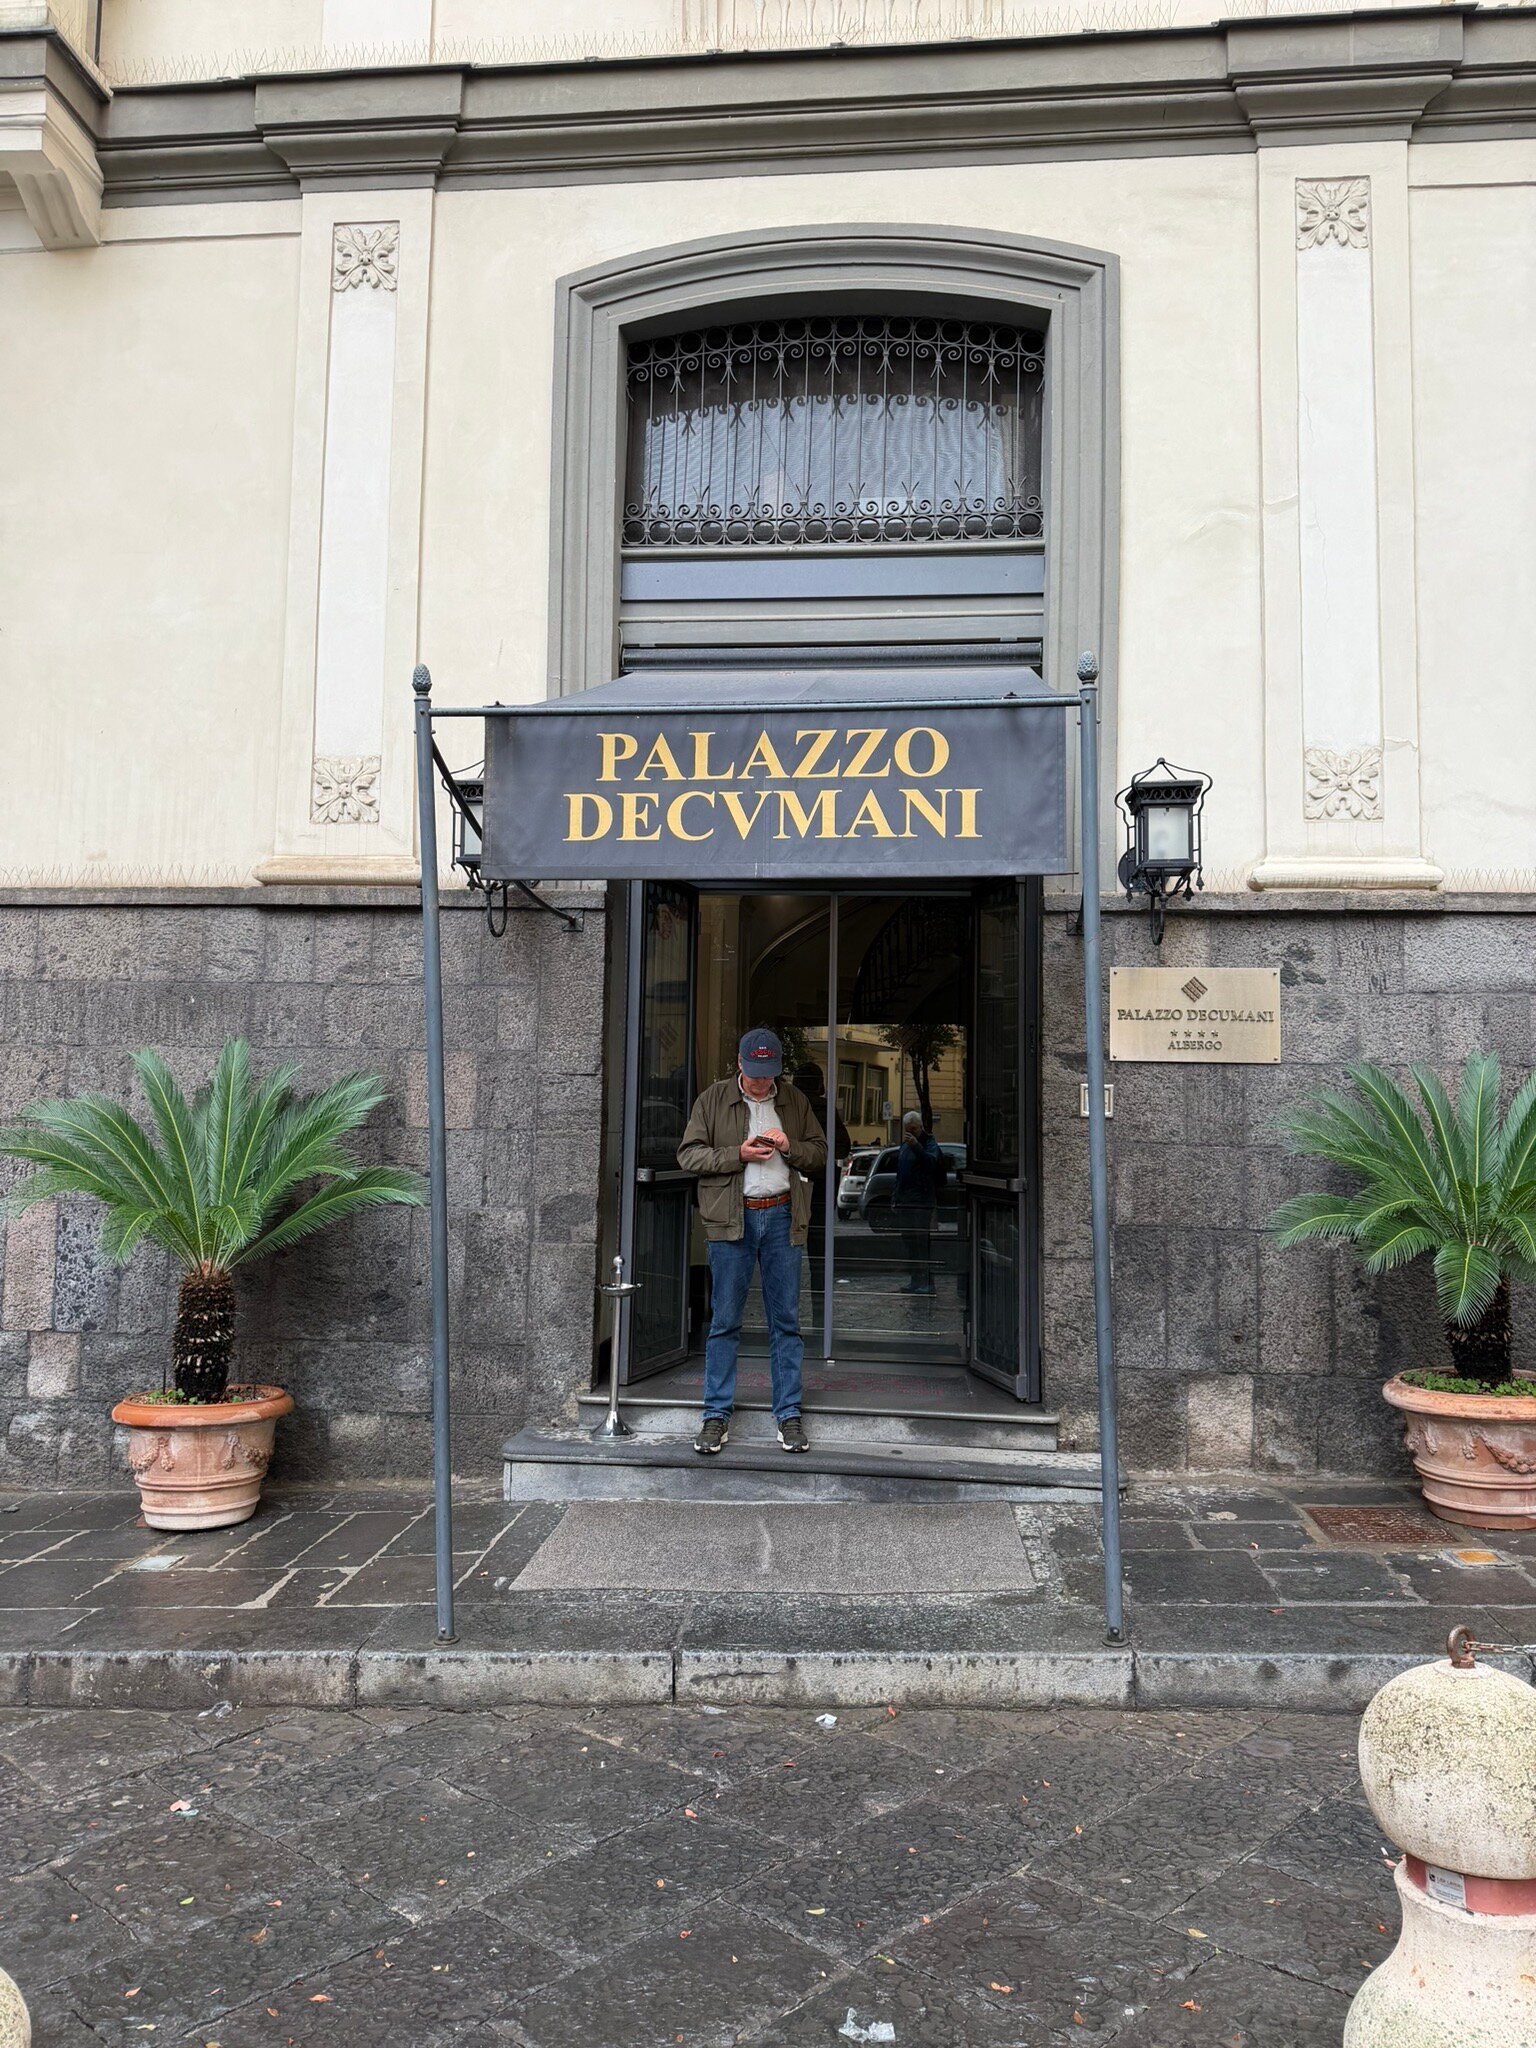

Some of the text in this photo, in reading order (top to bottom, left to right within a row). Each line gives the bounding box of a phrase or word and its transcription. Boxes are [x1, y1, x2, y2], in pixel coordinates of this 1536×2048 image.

[596, 726, 949, 782] PALAZZO
[563, 788, 982, 841] DECVMANI
[1117, 1009, 1274, 1023] PALAZZO DECUMANI
[1167, 1040, 1222, 1050] ALBERGO
